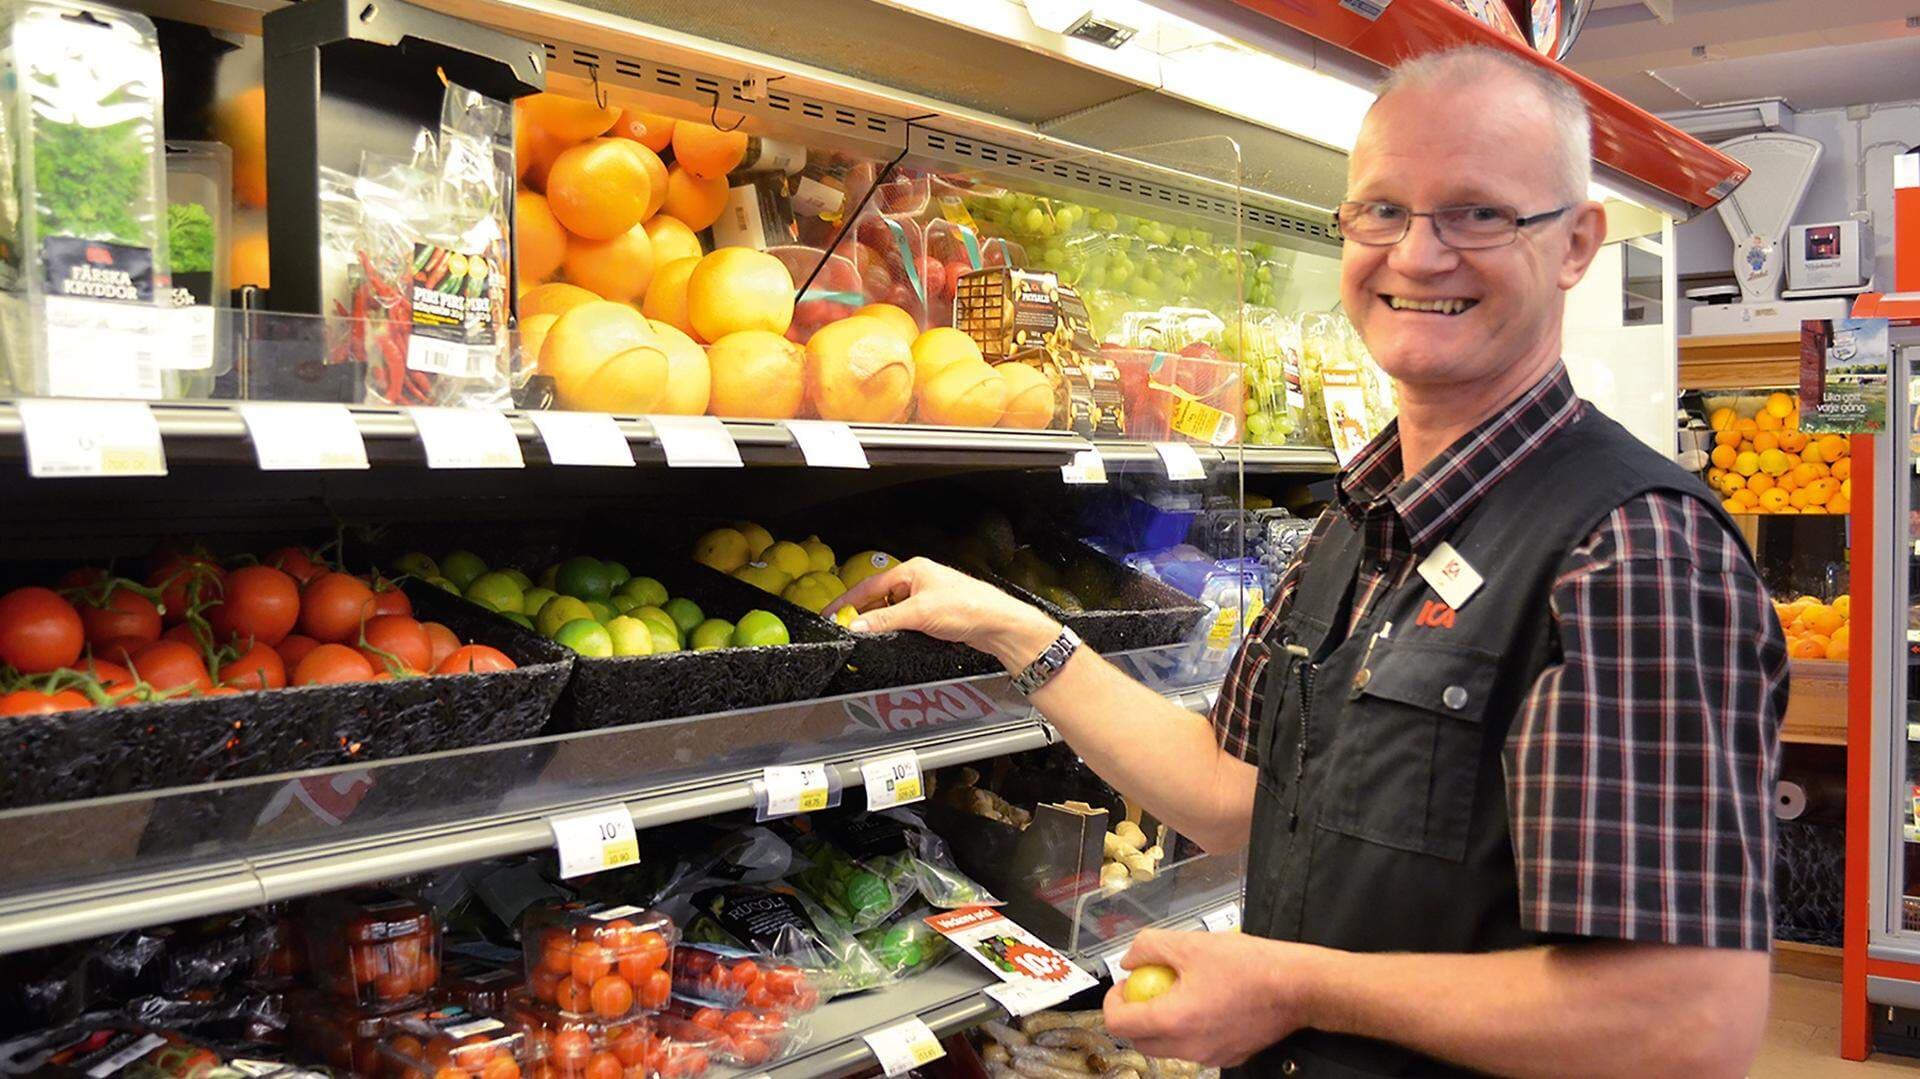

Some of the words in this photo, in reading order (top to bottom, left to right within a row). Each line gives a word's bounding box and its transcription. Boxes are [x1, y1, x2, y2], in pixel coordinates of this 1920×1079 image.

[71, 264, 132, 286] FÄRSKA
[64, 279, 138, 300] KRYDDOR
[1823, 392, 1841, 402] Lika
[1816, 403, 1839, 414] varje
[1415, 600, 1456, 629] ICA
[892, 764, 905, 780] 10
[600, 822, 616, 840] 10
